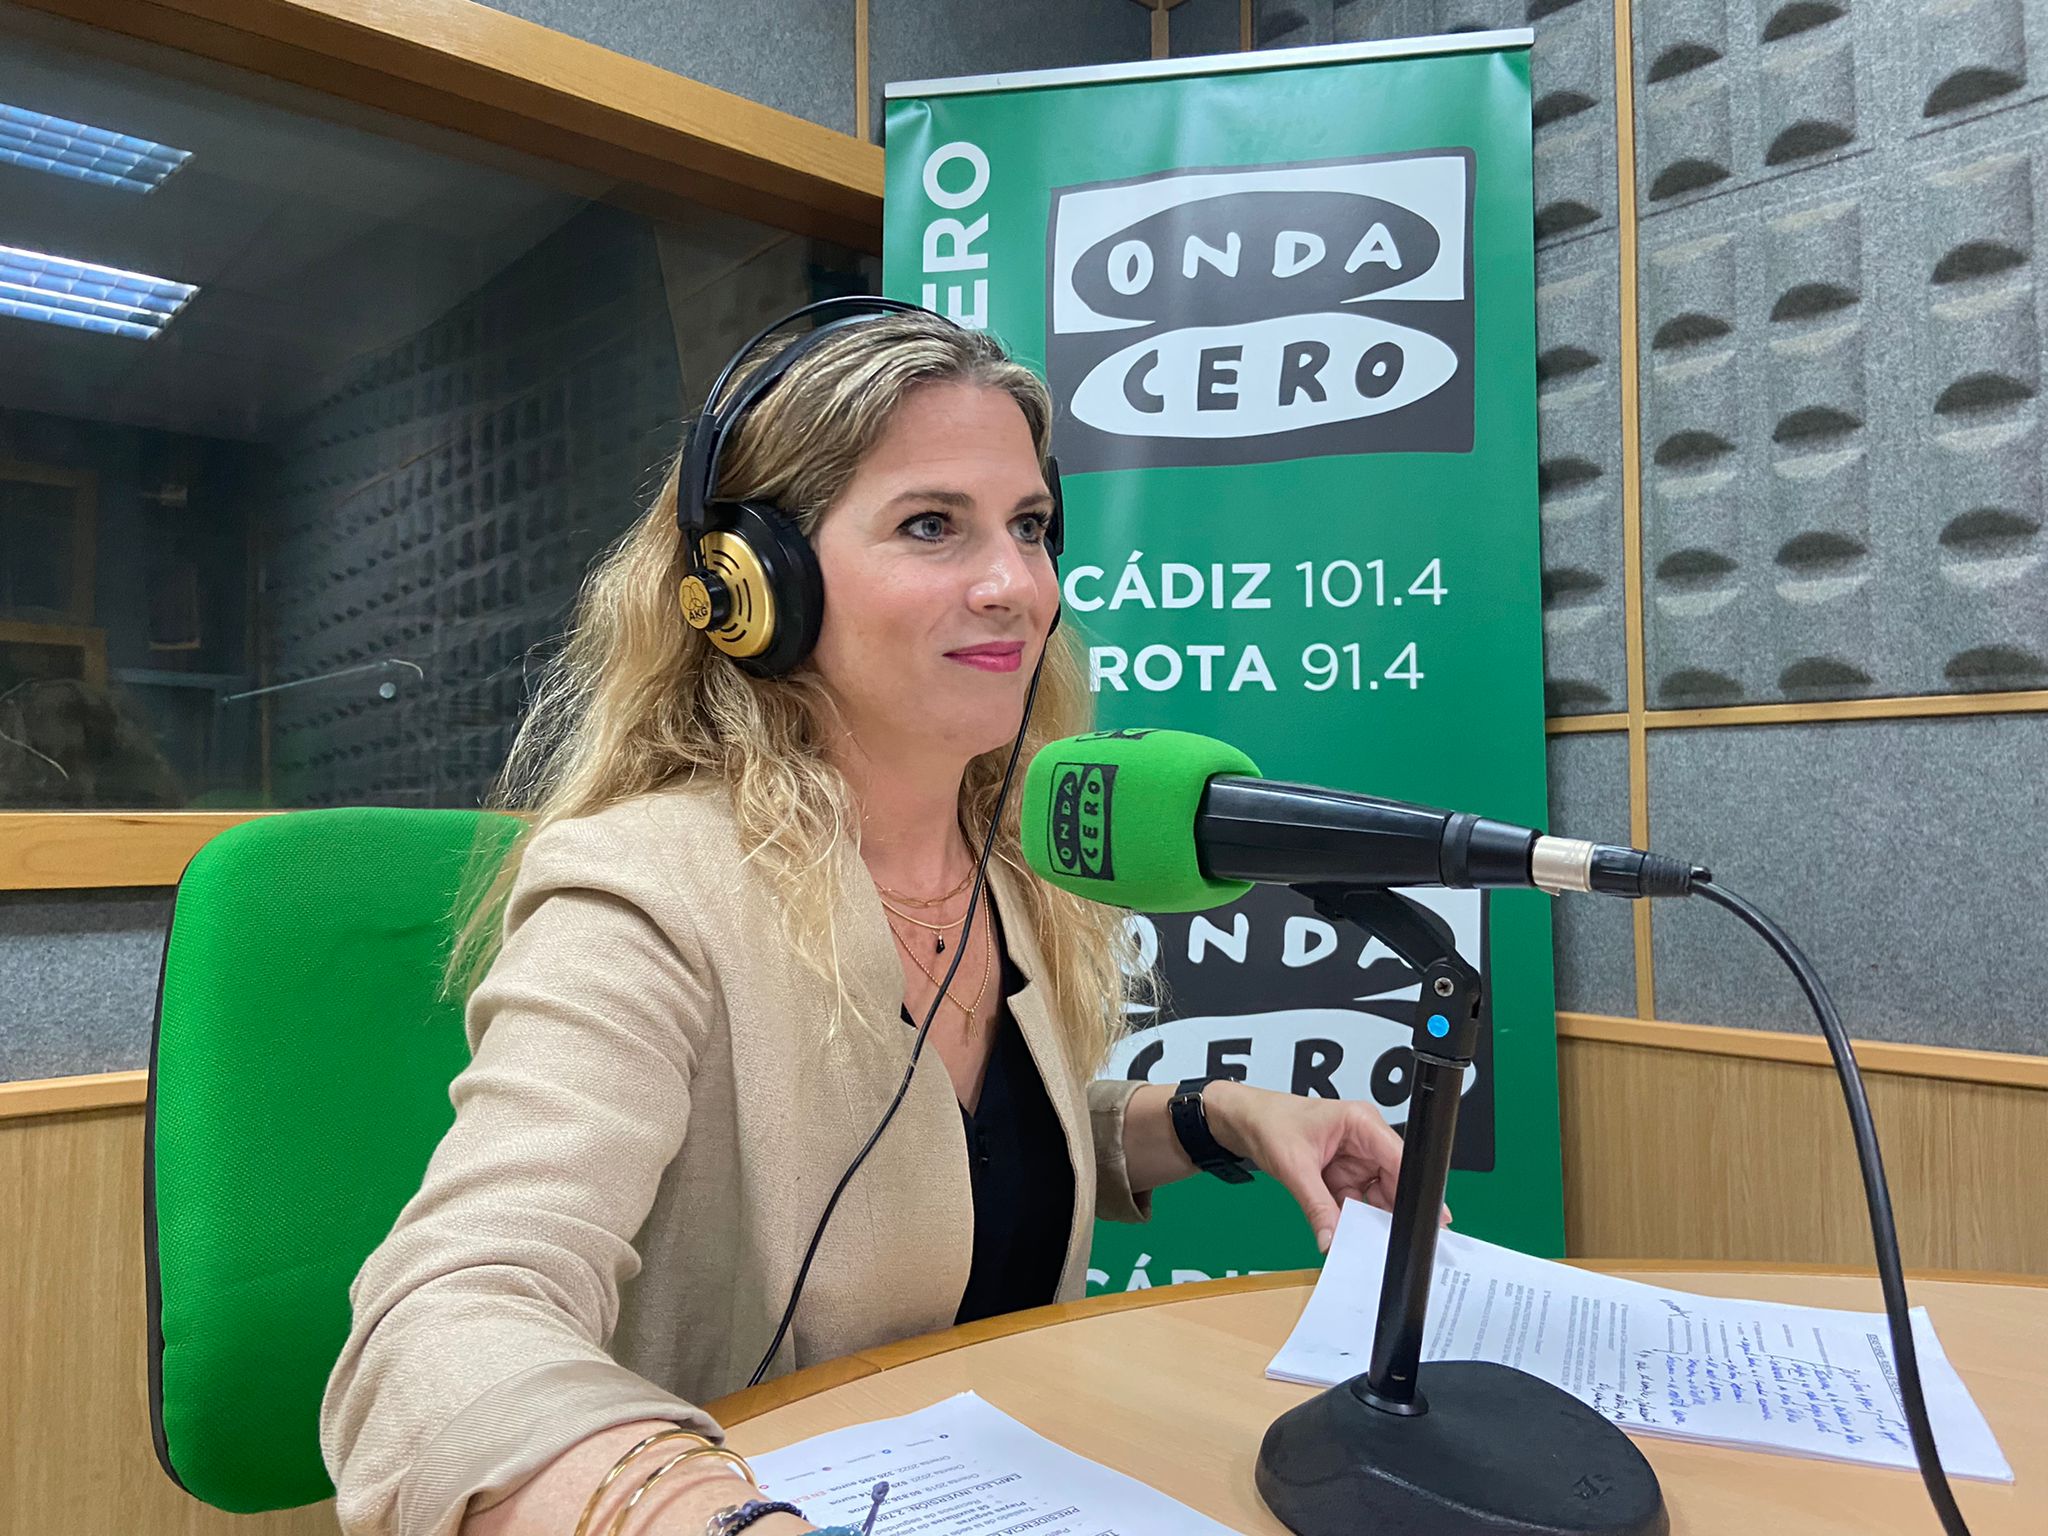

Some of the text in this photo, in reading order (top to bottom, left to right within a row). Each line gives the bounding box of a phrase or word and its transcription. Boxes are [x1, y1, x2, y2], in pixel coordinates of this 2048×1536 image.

[1106, 222, 1402, 295] ONDA
[1123, 340, 1405, 413] CERO
[688, 606, 709, 621] AKG
[1063, 550, 1449, 612] CÁDIZ 101.4
[1088, 641, 1425, 692] ROTA 91.4
[1059, 781, 1074, 861] ONDA
[1082, 780, 1101, 859] CERO
